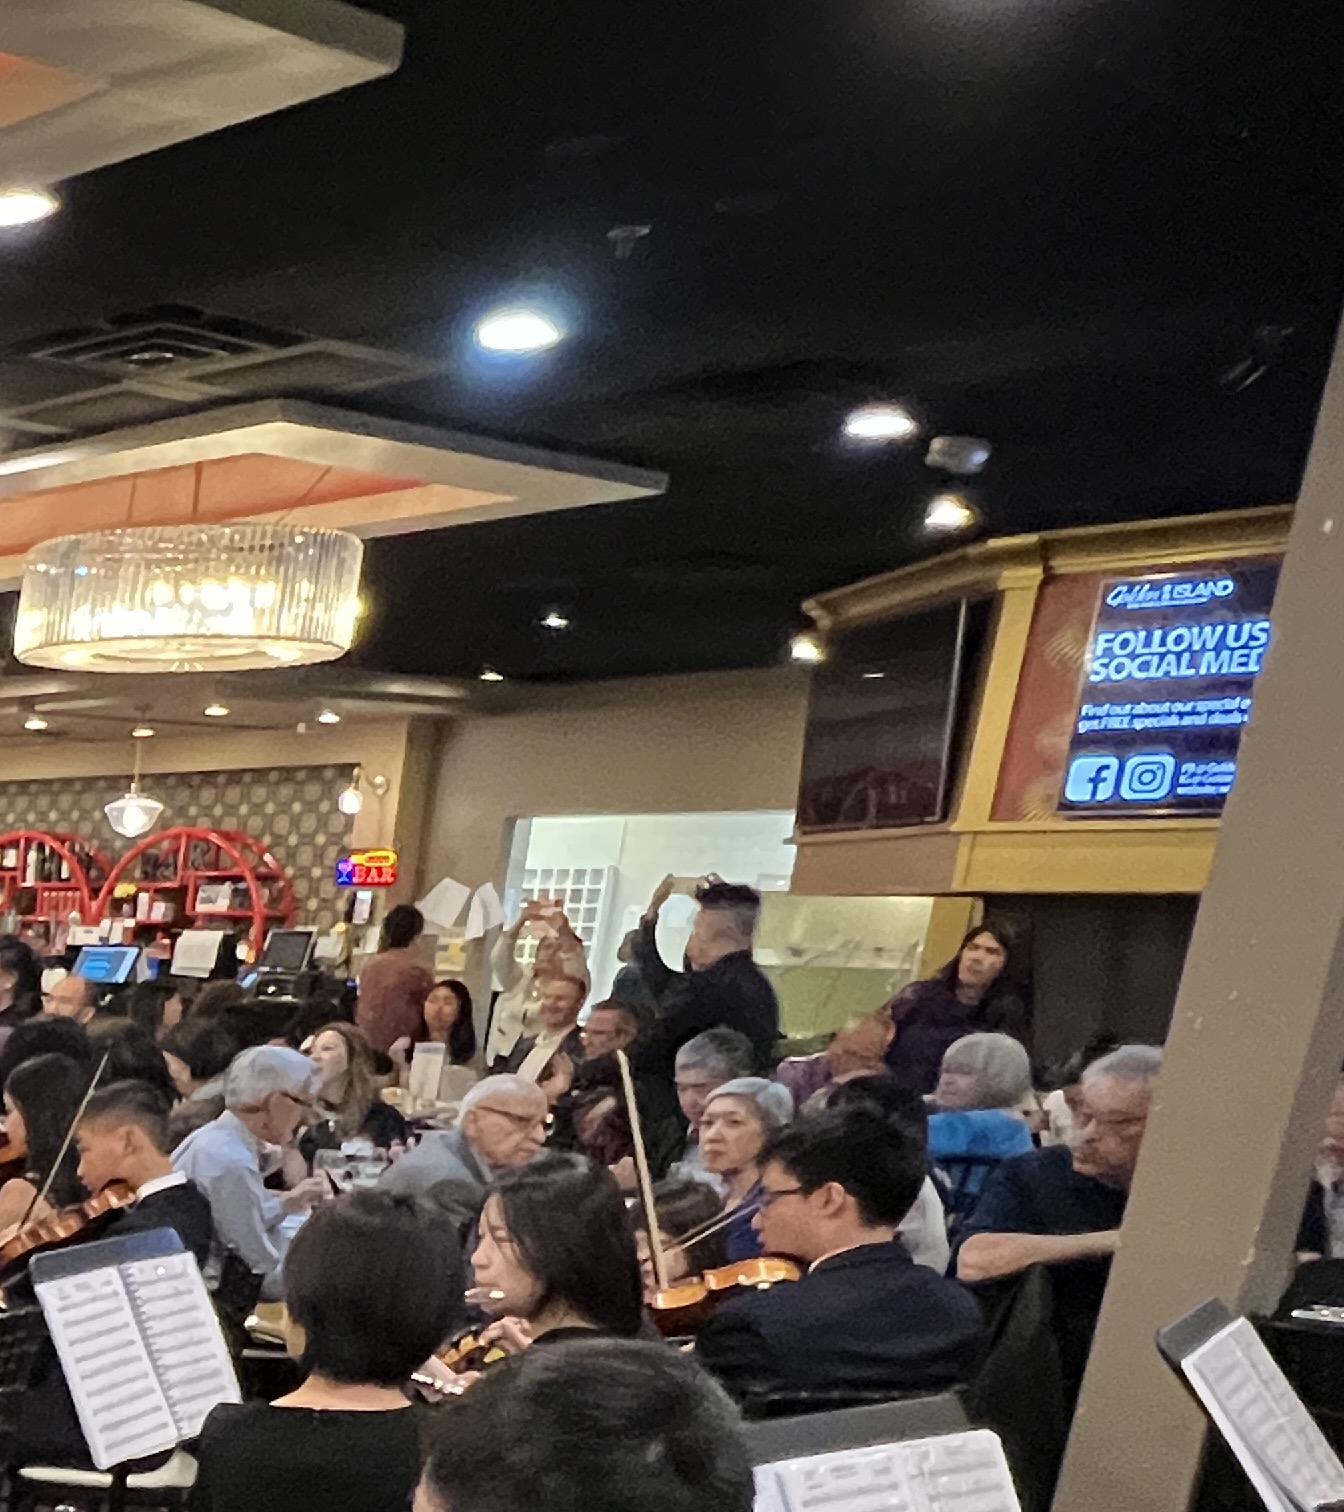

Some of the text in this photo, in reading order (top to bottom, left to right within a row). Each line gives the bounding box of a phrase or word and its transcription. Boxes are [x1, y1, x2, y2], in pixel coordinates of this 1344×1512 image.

[1095, 621, 1270, 656] FOLLOW US
[1089, 652, 1196, 682] SOCIAL
[352, 866, 395, 884] BAR
